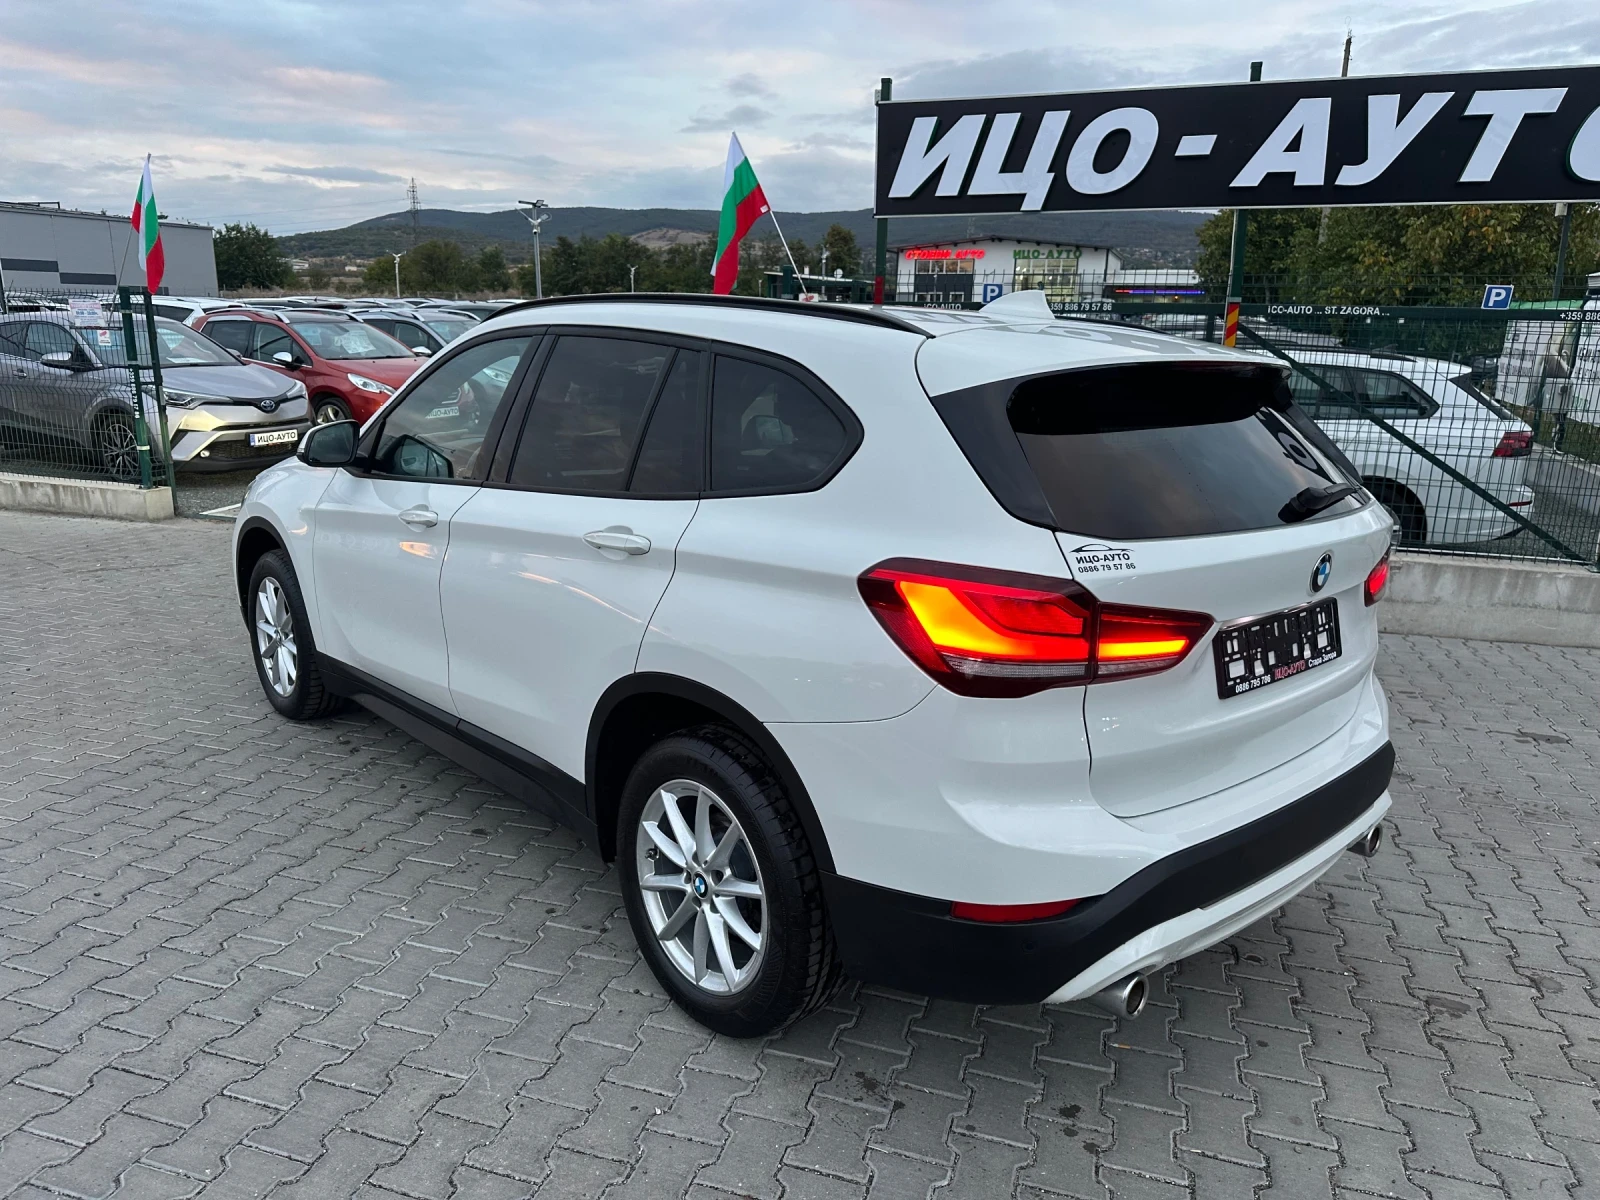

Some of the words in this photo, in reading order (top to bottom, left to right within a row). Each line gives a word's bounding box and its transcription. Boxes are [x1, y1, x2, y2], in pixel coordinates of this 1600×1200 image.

[1013, 249, 1083, 260] ИЦО-АУТО
[986, 285, 999, 302] P
[1487, 288, 1507, 307] P
[1080, 302, 1090, 311] 79
[1091, 302, 1101, 311] 57
[1102, 302, 1113, 311] 86
[1324, 305, 1338, 315] ST.
[1339, 306, 1381, 316] ZAGORA
[1560, 311, 1583, 321] +359
[257, 431, 296, 444] ИЦО-АУТО
[1075, 552, 1130, 565] ИЦО-АУТО
[1078, 565, 1099, 573] 0886
[1125, 562, 1136, 570] 86
[1235, 681, 1249, 693] 0886
[1250, 677, 1260, 688] 795
